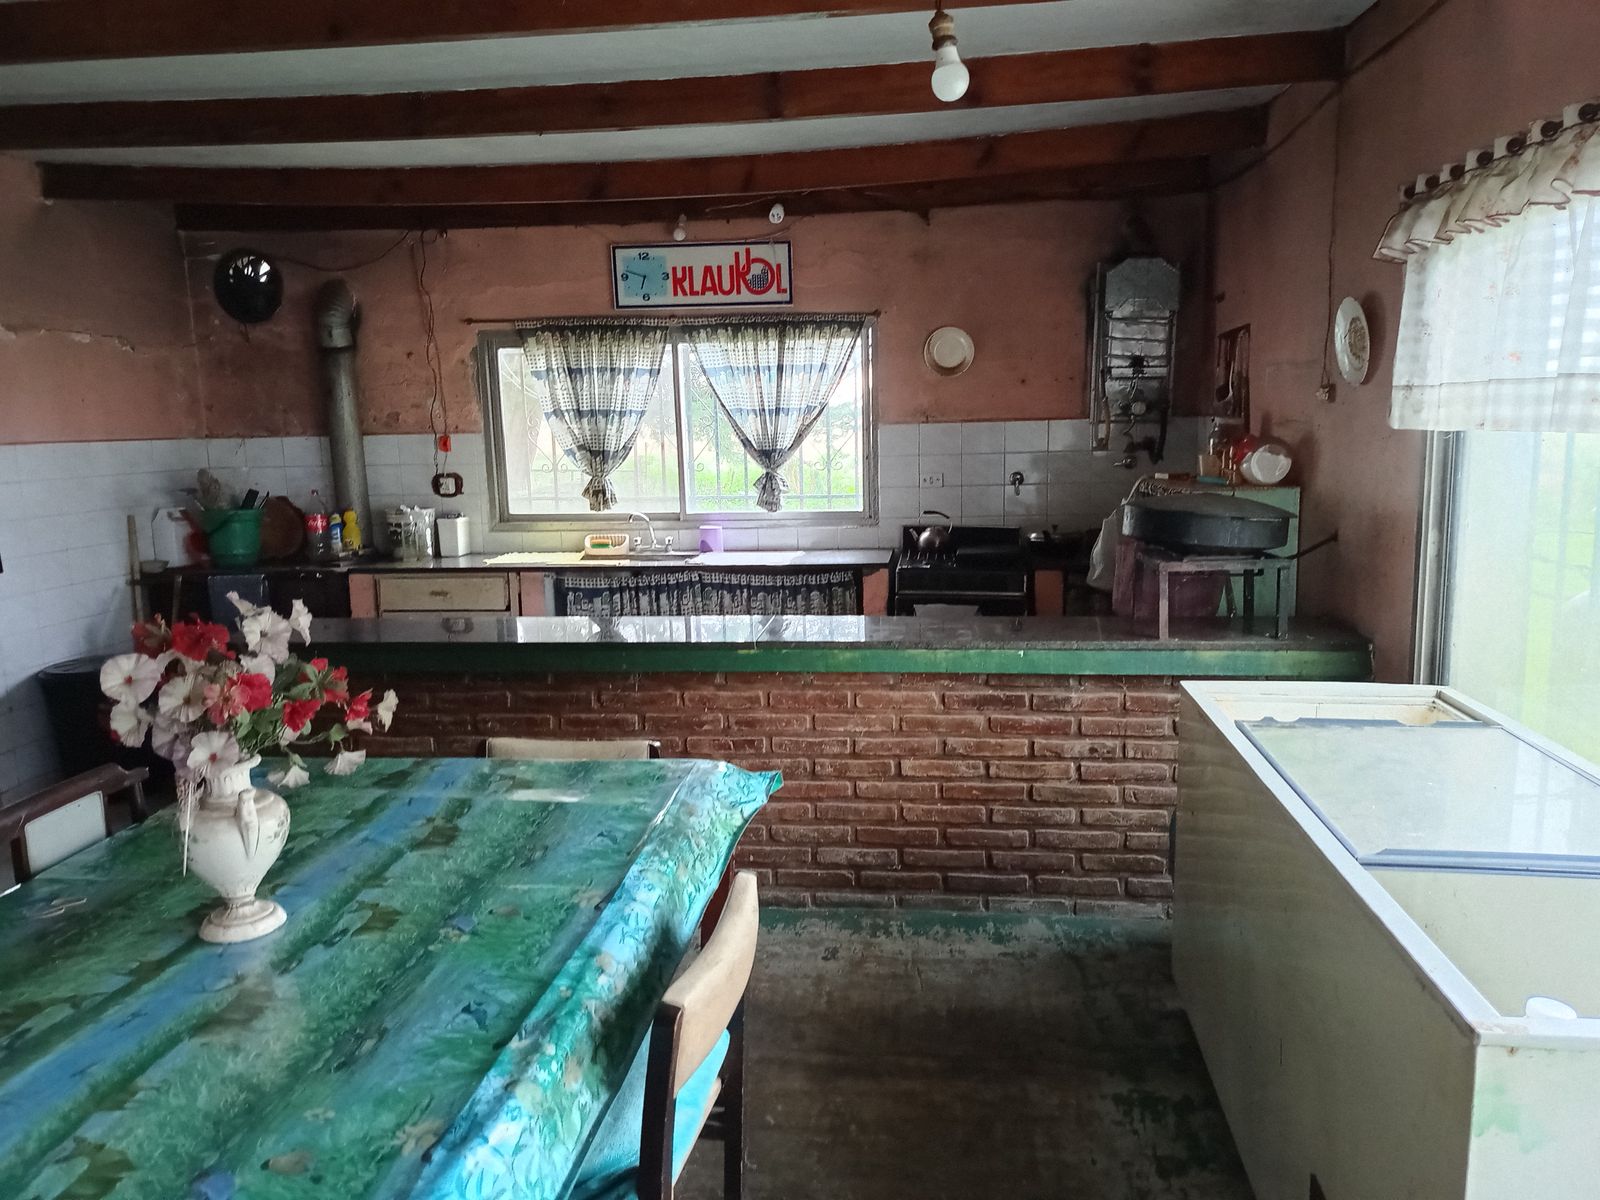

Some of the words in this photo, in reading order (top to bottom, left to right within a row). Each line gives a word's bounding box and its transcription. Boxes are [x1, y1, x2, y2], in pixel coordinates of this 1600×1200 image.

[638, 252, 650, 260] 12
[621, 272, 629, 282] 9
[661, 271, 669, 281] 3
[672, 247, 788, 297] KLAUKOL
[642, 293, 650, 301] 6
